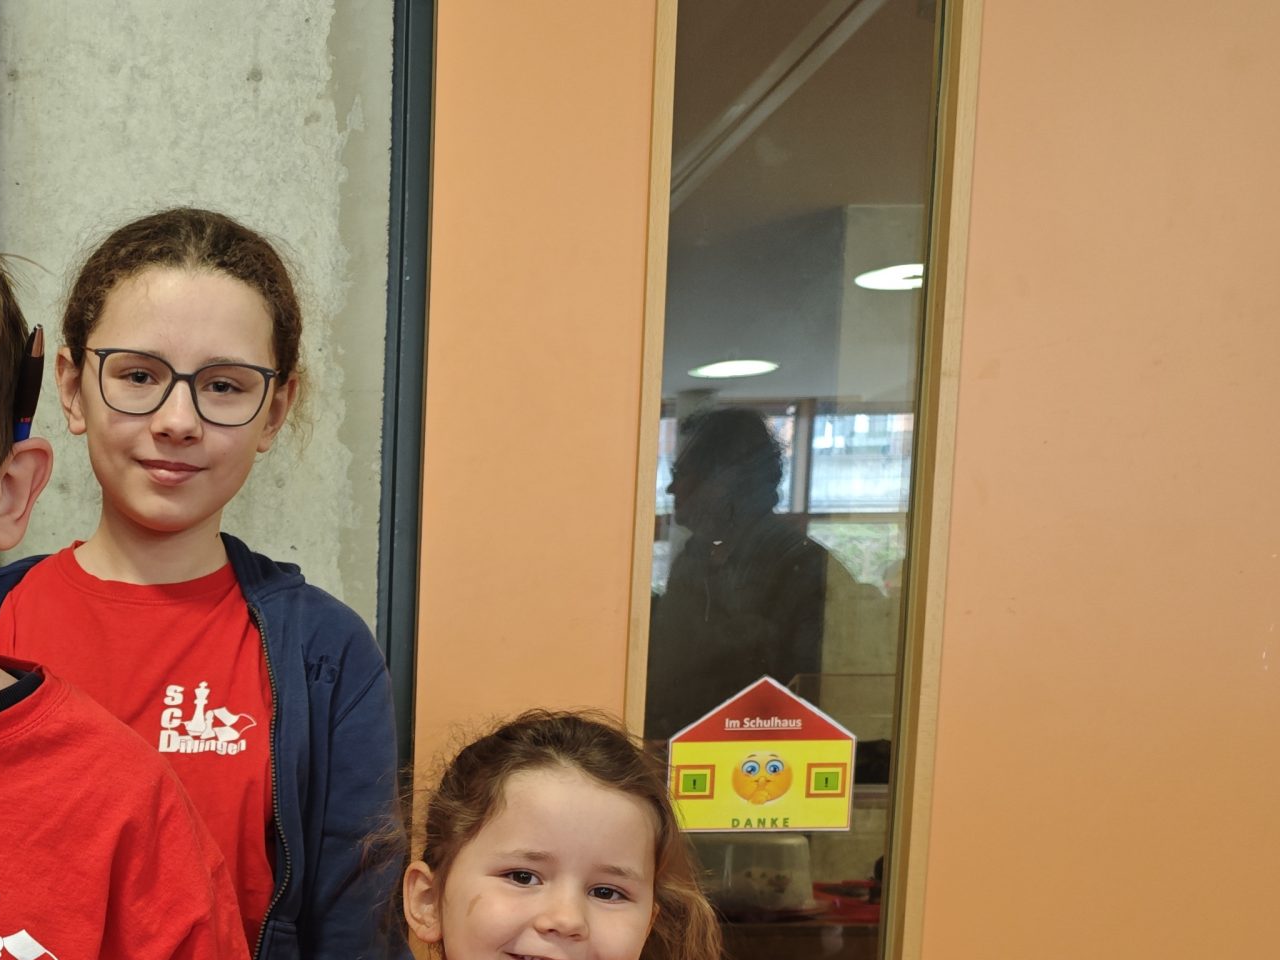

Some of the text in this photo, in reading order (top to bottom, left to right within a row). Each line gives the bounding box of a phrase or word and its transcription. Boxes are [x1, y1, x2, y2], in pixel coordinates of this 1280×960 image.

[725, 717, 802, 729] Im Schulhaus
[159, 729, 247, 755] Dillingen
[692, 778, 697, 790] !
[824, 776, 829, 788] !
[731, 817, 790, 828] DANKE
